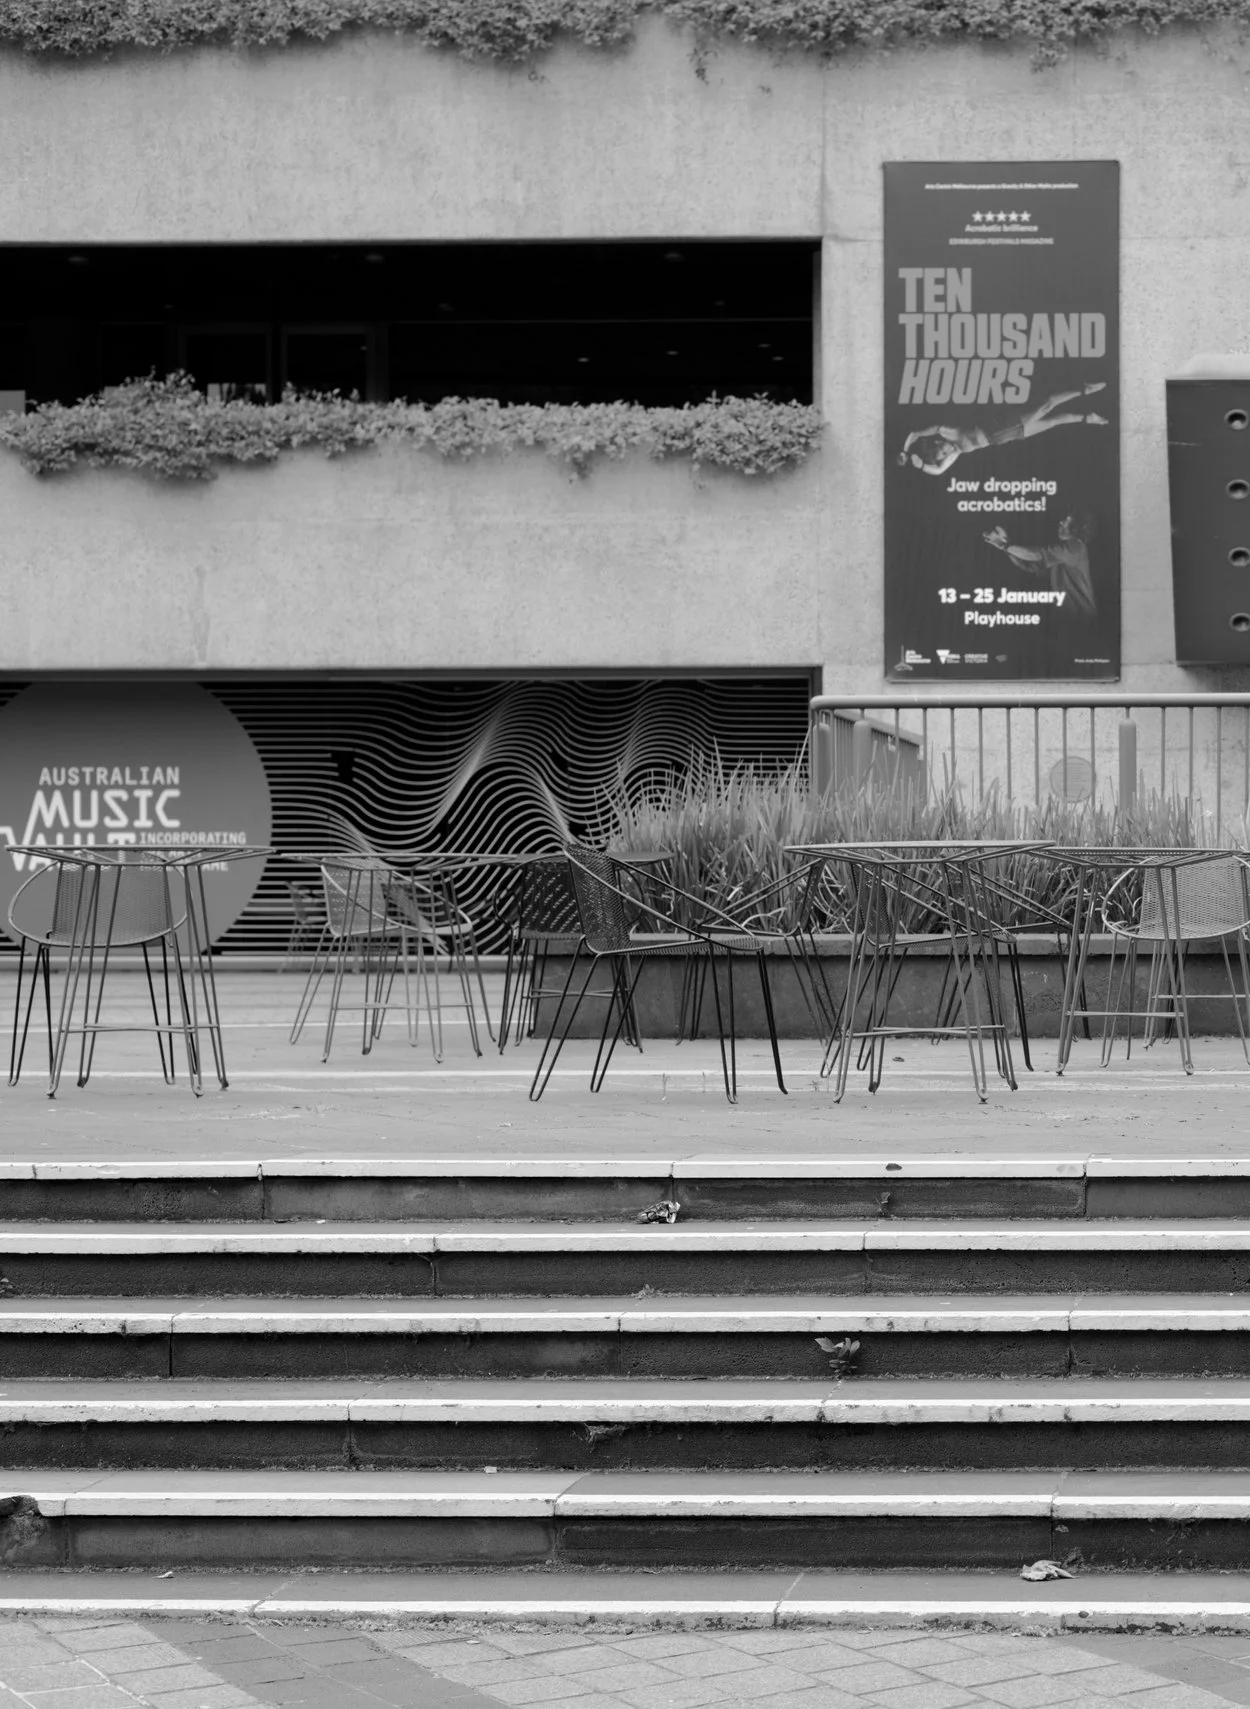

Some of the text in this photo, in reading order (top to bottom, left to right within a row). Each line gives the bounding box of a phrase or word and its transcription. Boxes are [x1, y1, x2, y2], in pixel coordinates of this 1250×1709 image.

[899, 268, 972, 313] TEN
[899, 313, 1106, 358] THOUSAND
[898, 359, 1035, 404] HOURS
[947, 477, 1057, 496] Jaw dropping
[957, 497, 1047, 512] acrobatics!
[938, 588, 957, 604] 13
[974, 588, 994, 604] 25
[997, 588, 1066, 606] January
[964, 611, 1041, 628] Playhouse
[39, 767, 180, 786] AUSTRALIAN
[29, 788, 181, 829] MUSIC
[138, 832, 247, 845] INCORPORATING
